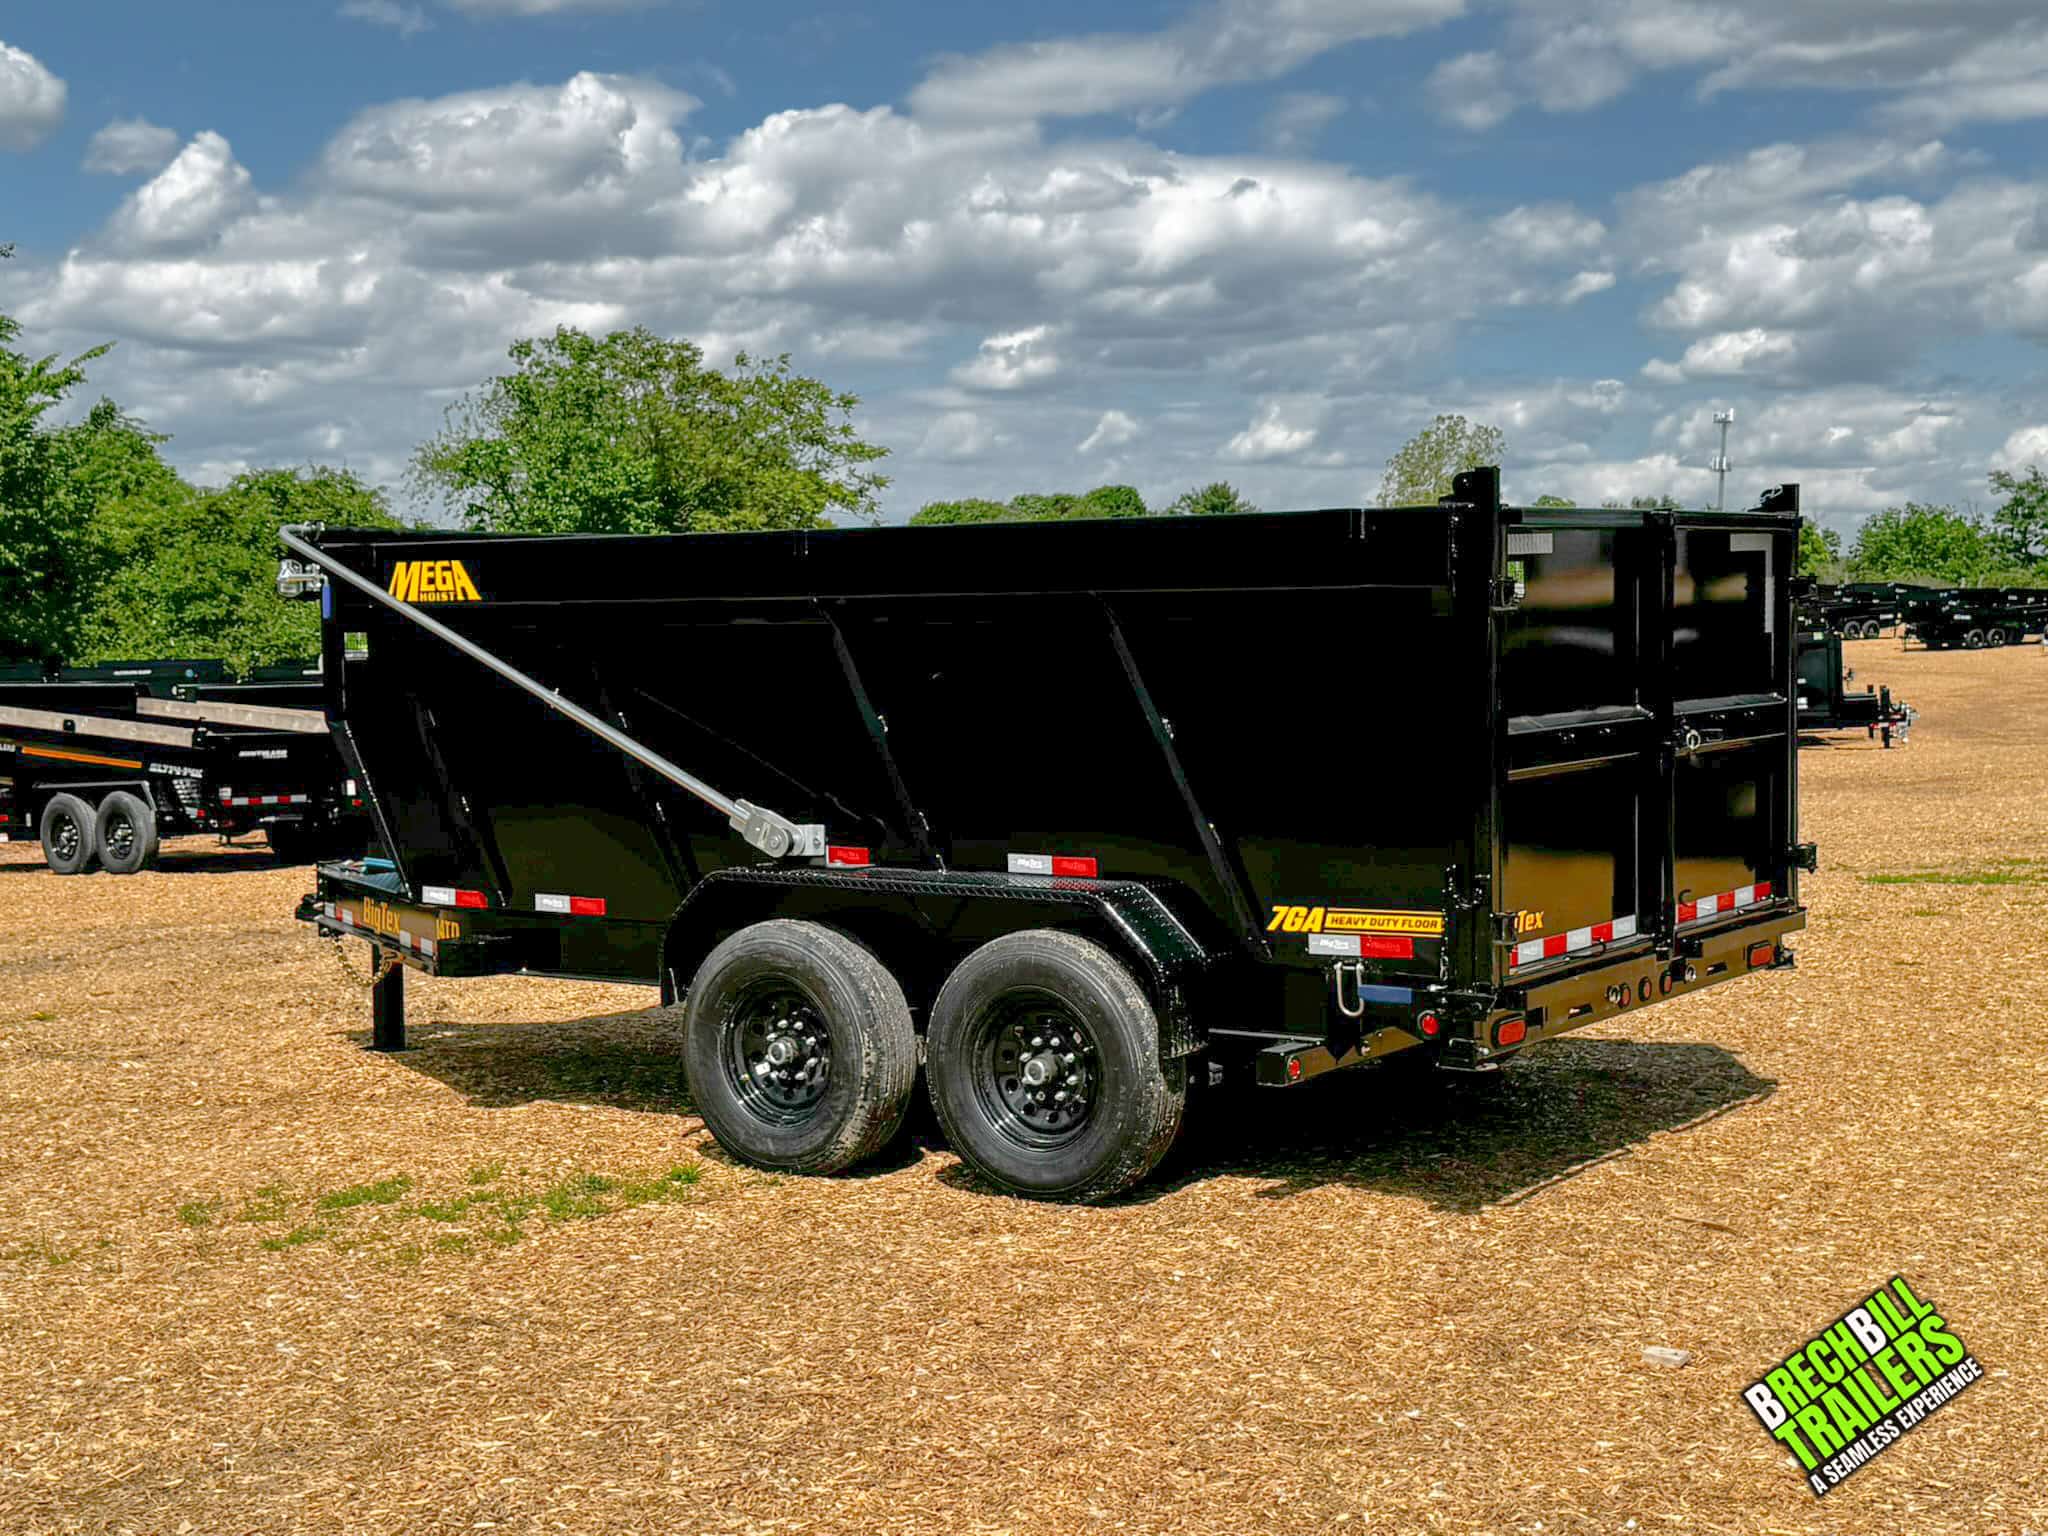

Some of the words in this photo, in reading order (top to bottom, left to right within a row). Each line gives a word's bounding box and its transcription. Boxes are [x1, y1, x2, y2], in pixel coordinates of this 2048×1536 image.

[388, 560, 482, 602] MEGA
[420, 592, 456, 602] HOIST
[363, 896, 401, 934] BigTex
[1266, 905, 1326, 933] 7GA
[1330, 915, 1367, 927] HEAVY
[1369, 917, 1399, 928] DUTY
[1401, 919, 1439, 929] FLOOR
